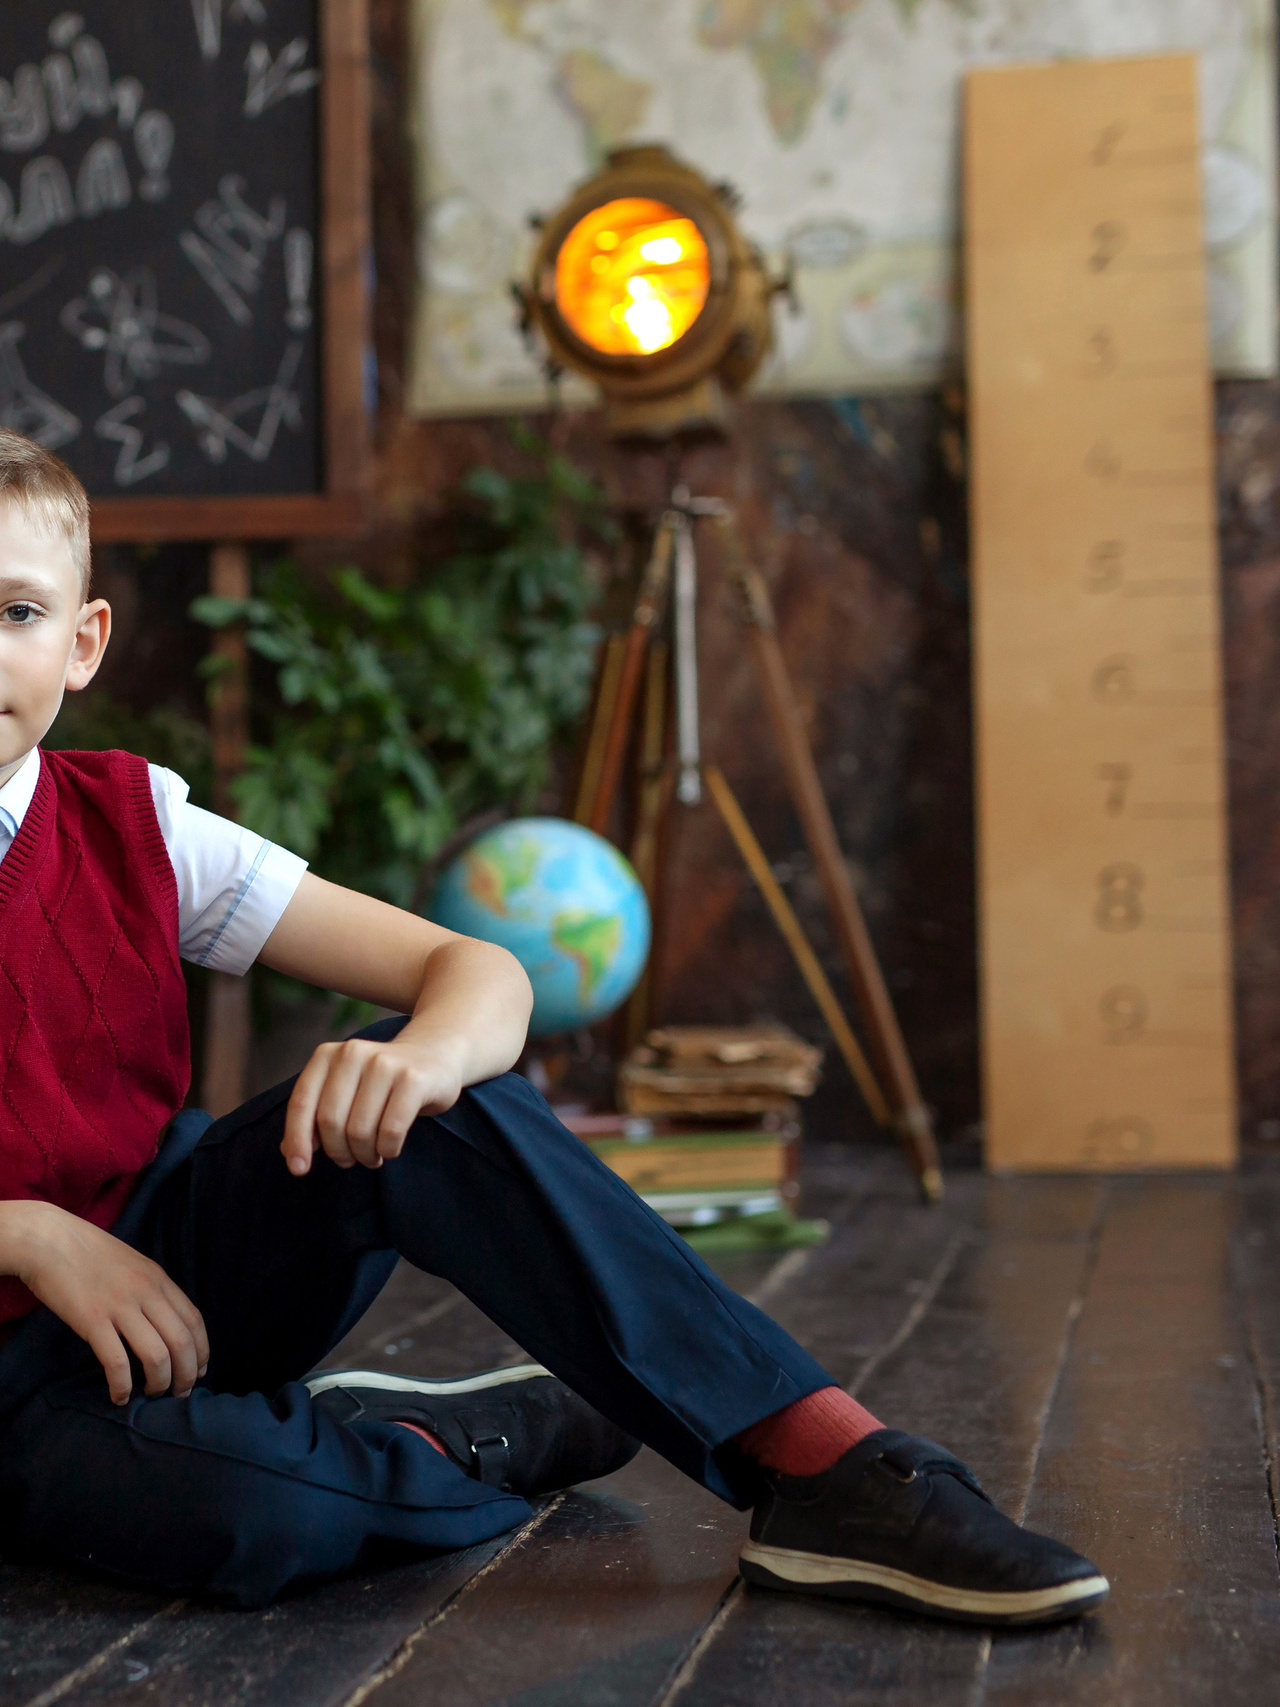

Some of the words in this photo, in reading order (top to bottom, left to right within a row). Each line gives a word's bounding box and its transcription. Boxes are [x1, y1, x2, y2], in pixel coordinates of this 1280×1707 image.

[1094, 760, 1135, 818] 7
[1092, 859, 1147, 934] 8
[1096, 982, 1150, 1047] 9
